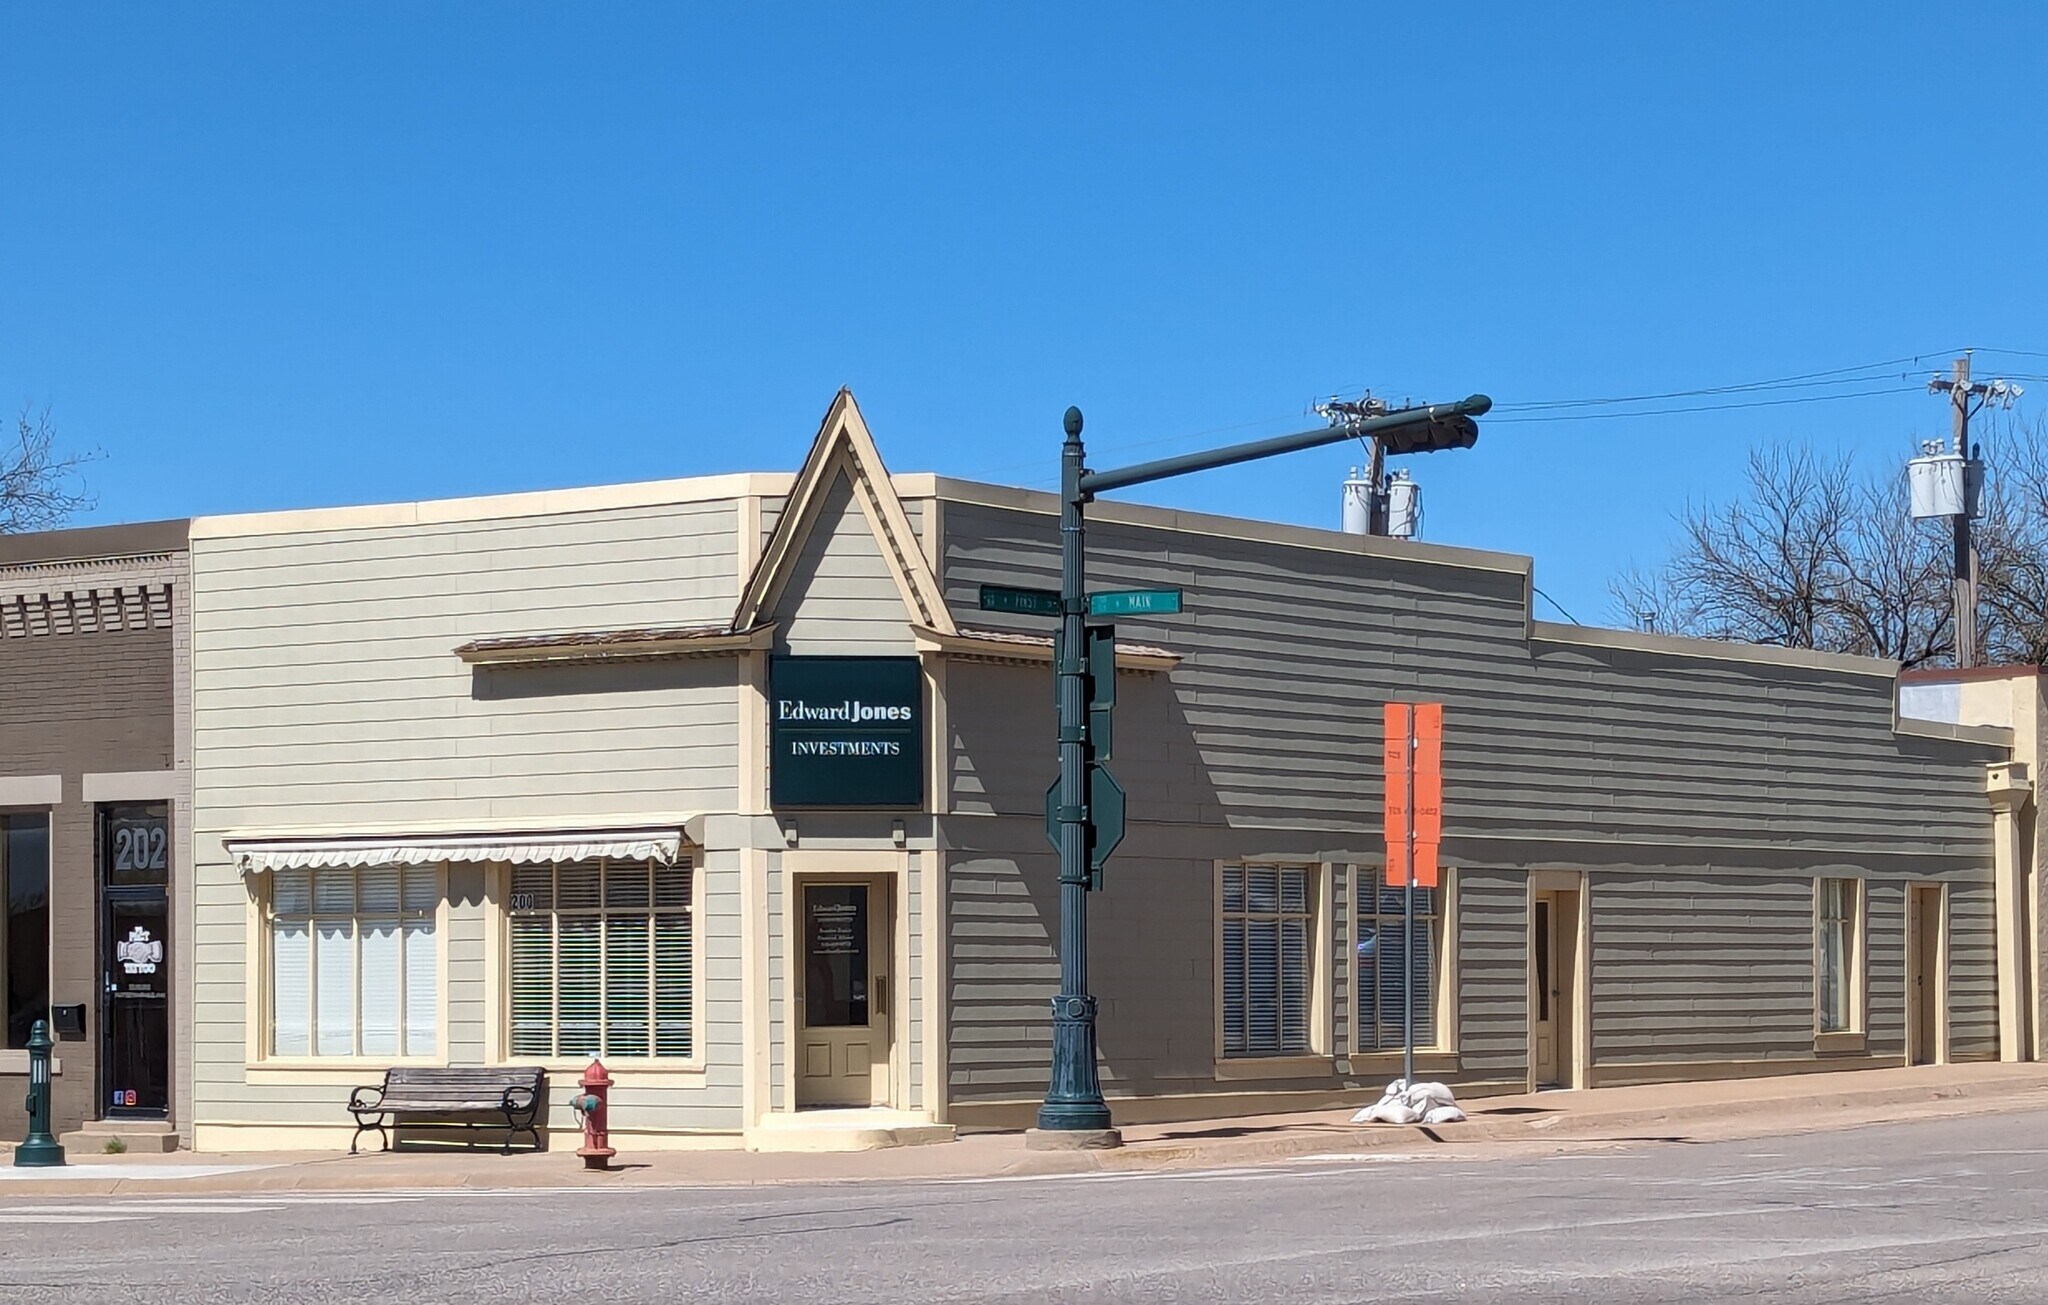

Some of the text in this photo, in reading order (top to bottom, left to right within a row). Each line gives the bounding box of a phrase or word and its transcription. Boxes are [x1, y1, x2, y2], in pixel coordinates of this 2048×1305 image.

[1128, 594, 1151, 609] MAIN
[791, 741, 900, 756] INVESTMENTS
[116, 827, 166, 870] 202
[511, 894, 532, 909] 200
